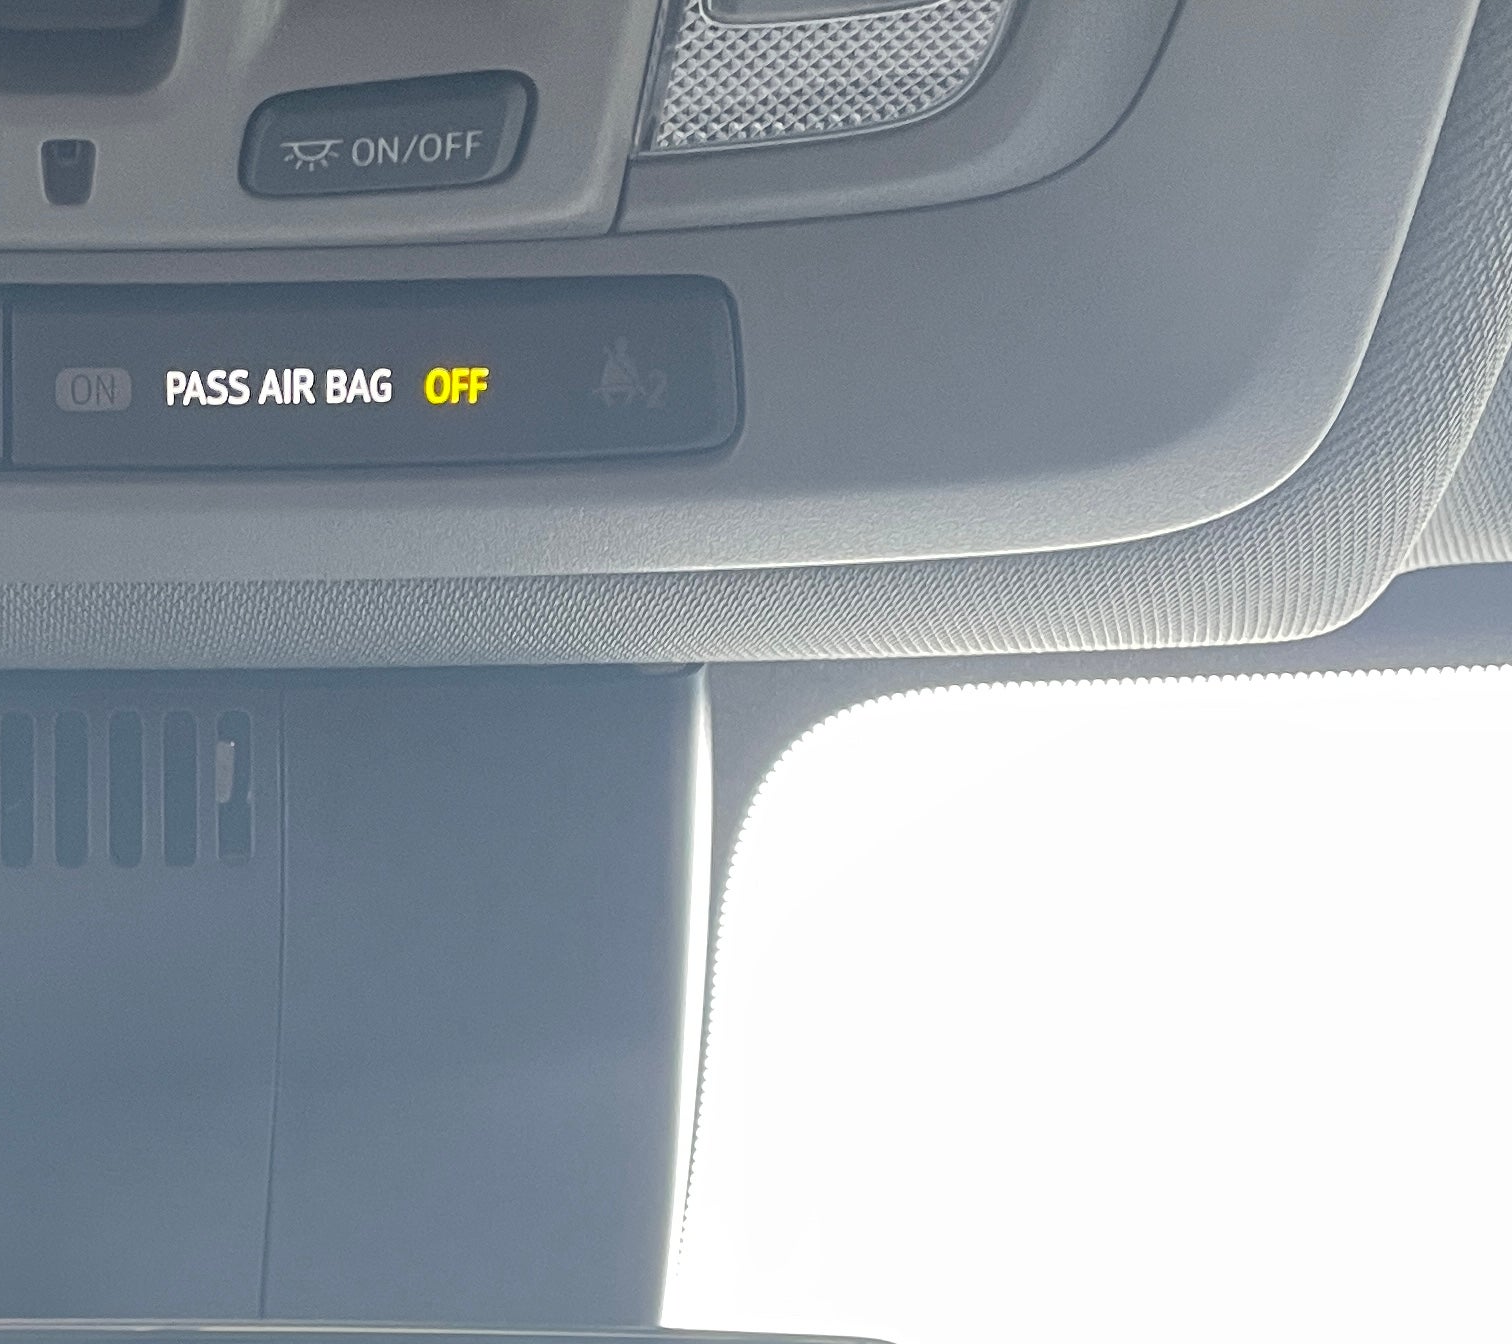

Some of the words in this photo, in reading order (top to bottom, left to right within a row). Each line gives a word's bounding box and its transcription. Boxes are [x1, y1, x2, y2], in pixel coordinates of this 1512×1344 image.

[351, 129, 484, 167] ON/OFF
[68, 371, 118, 408] ON
[164, 368, 250, 407] PASS
[256, 367, 317, 406] AIR
[324, 366, 394, 405] BAG
[422, 365, 491, 406] OFF
